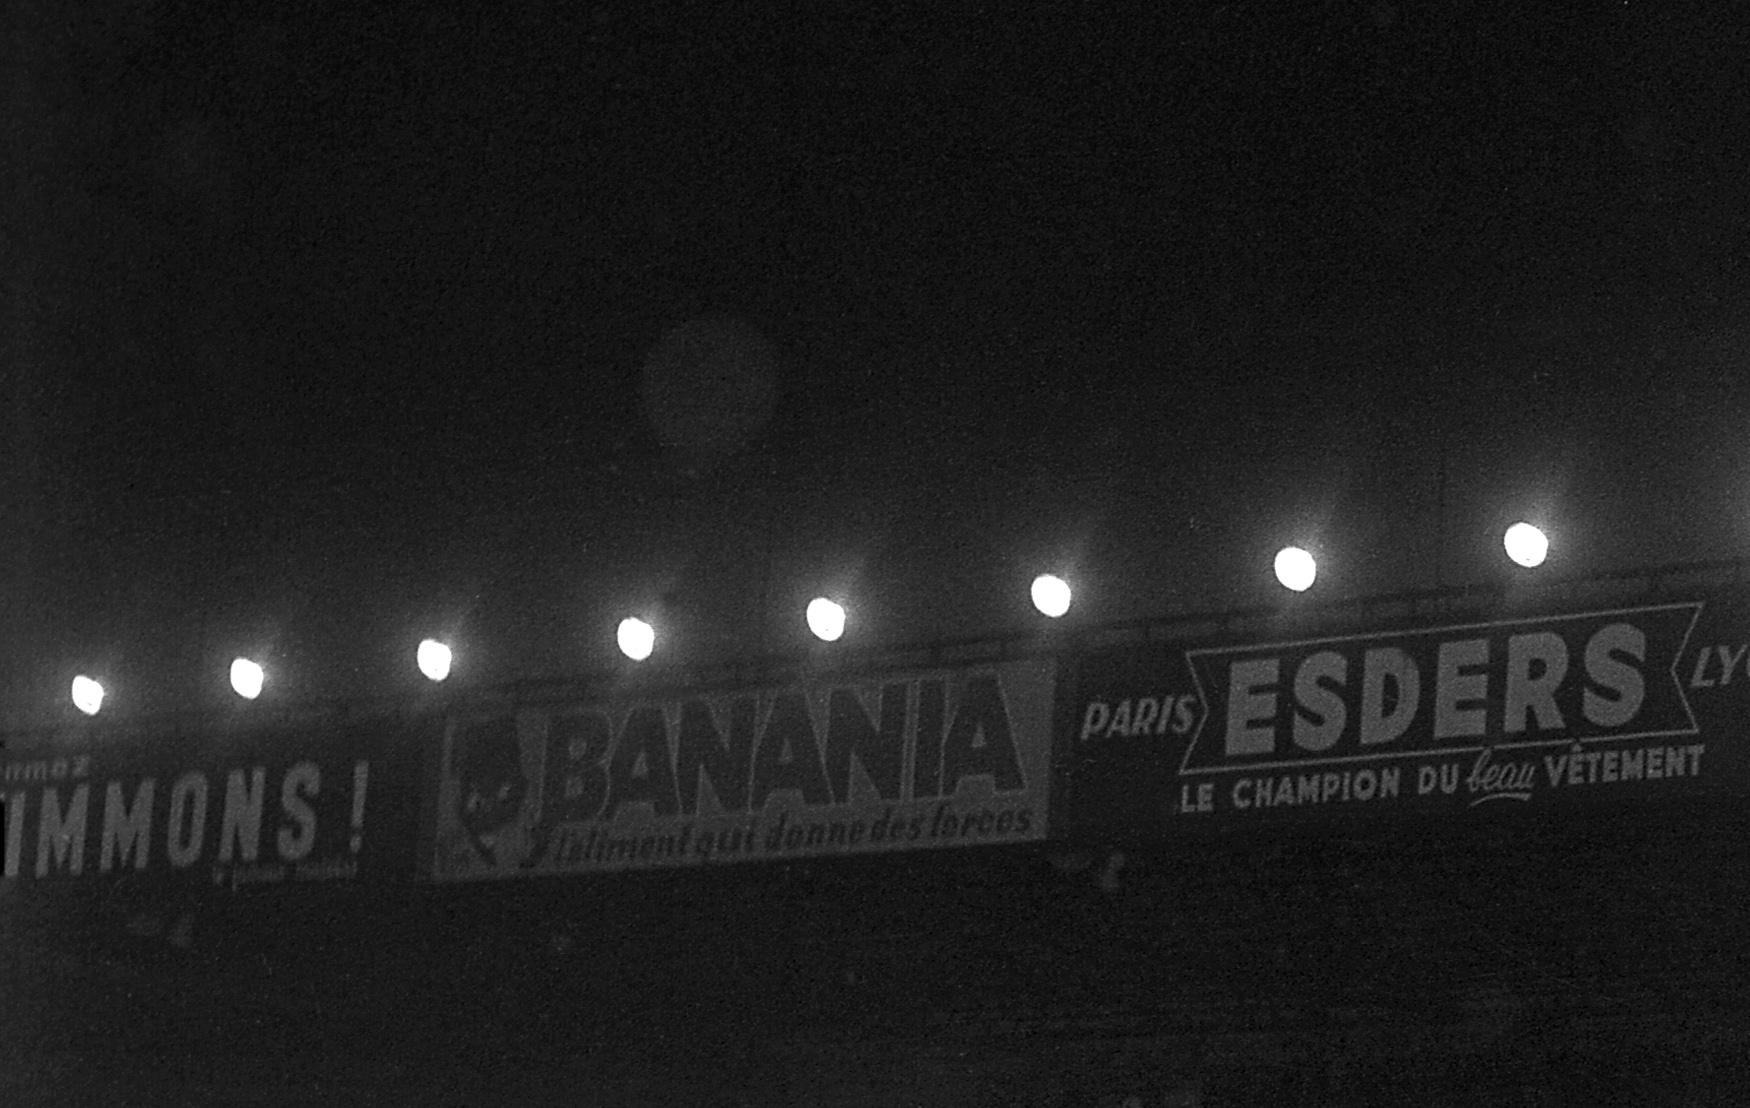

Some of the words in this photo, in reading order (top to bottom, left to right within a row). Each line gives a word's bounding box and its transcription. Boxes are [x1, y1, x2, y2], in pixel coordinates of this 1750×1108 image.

[1080, 693, 1198, 741] PARIS
[1224, 622, 1647, 757] ESDERS
[543, 670, 1025, 822] BANANIA
[1179, 782, 1214, 814] LE
[1232, 763, 1402, 810] CHAMPION
[1417, 763, 1456, 797] DU
[1465, 746, 1536, 796] beau
[1543, 743, 1706, 788] VÊTEMENT
[0, 760, 322, 880] IMMONS
[869, 804, 925, 842] des
